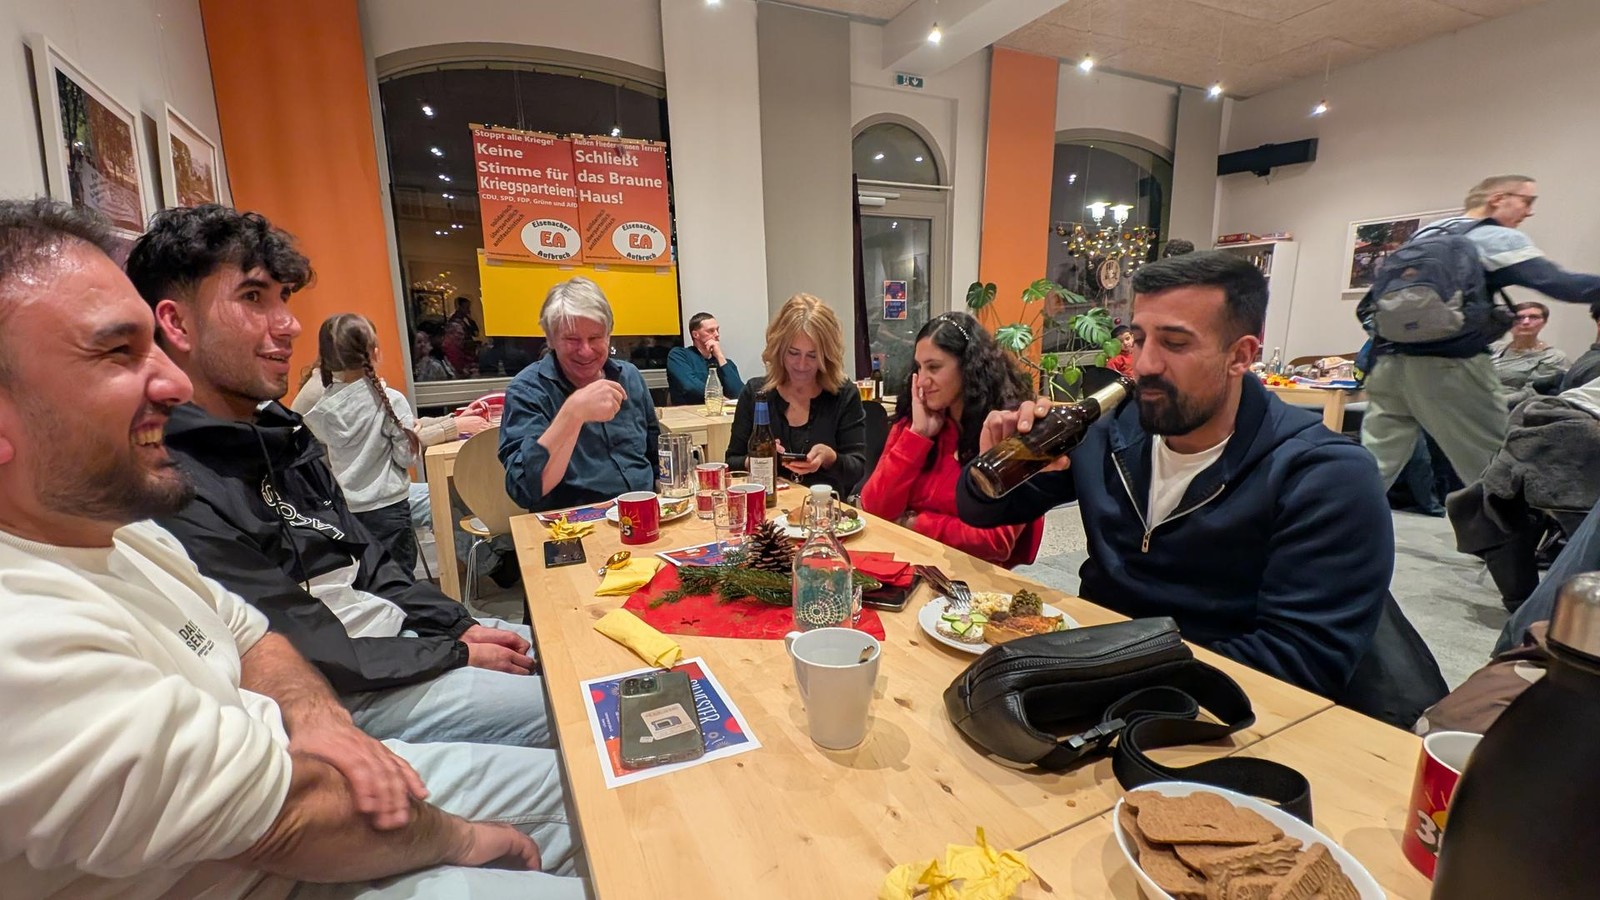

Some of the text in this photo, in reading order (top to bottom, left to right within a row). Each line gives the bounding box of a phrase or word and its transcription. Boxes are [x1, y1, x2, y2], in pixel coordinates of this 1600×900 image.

[475, 129, 554, 146] Stoppt alle Kriege!
[476, 142, 523, 159] Keine
[575, 149, 639, 167] Schließt
[478, 161, 569, 181] Stimme für
[577, 169, 662, 188] das Braune
[480, 176, 577, 198] Kriegsparteien!
[481, 193, 499, 201] CDU,
[533, 198, 552, 206] Grüne
[566, 201, 578, 209] AfD
[580, 189, 624, 205] Haus!
[531, 220, 572, 232] Eisenacher
[540, 230, 567, 248] EA
[628, 233, 653, 249] EA
[537, 250, 571, 260] Aufbruch
[261, 475, 345, 540] LACOS
